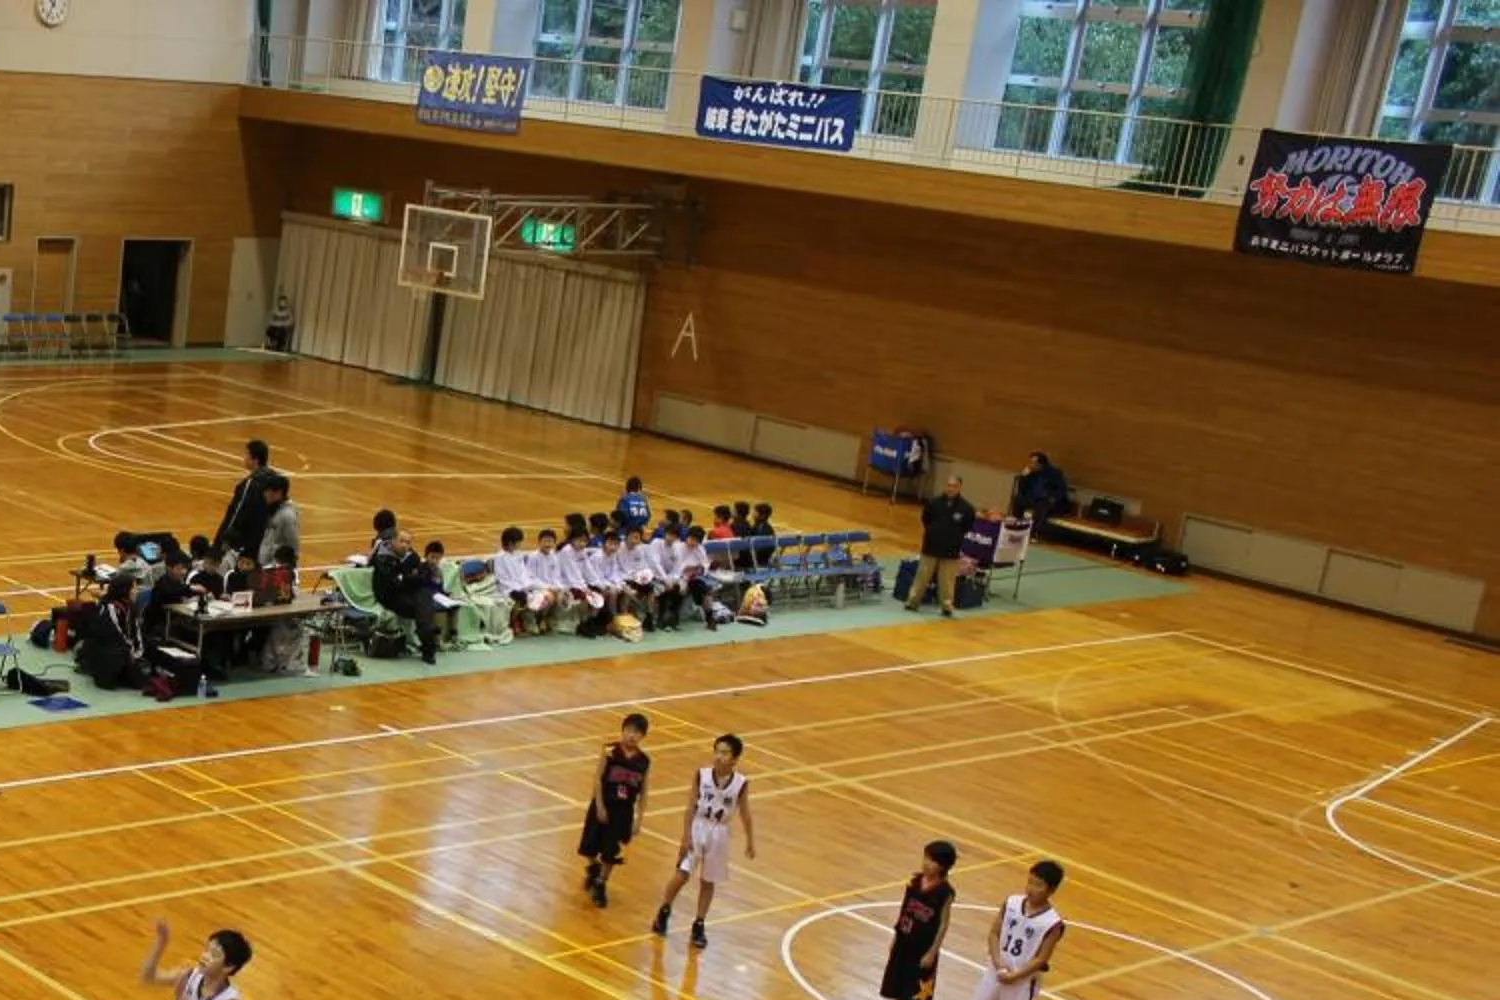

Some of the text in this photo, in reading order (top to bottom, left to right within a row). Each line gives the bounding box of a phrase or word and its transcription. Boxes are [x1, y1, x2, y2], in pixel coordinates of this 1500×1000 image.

[671, 311, 698, 362] A
[704, 806, 724, 822] 14
[1003, 935, 1024, 957] 18
